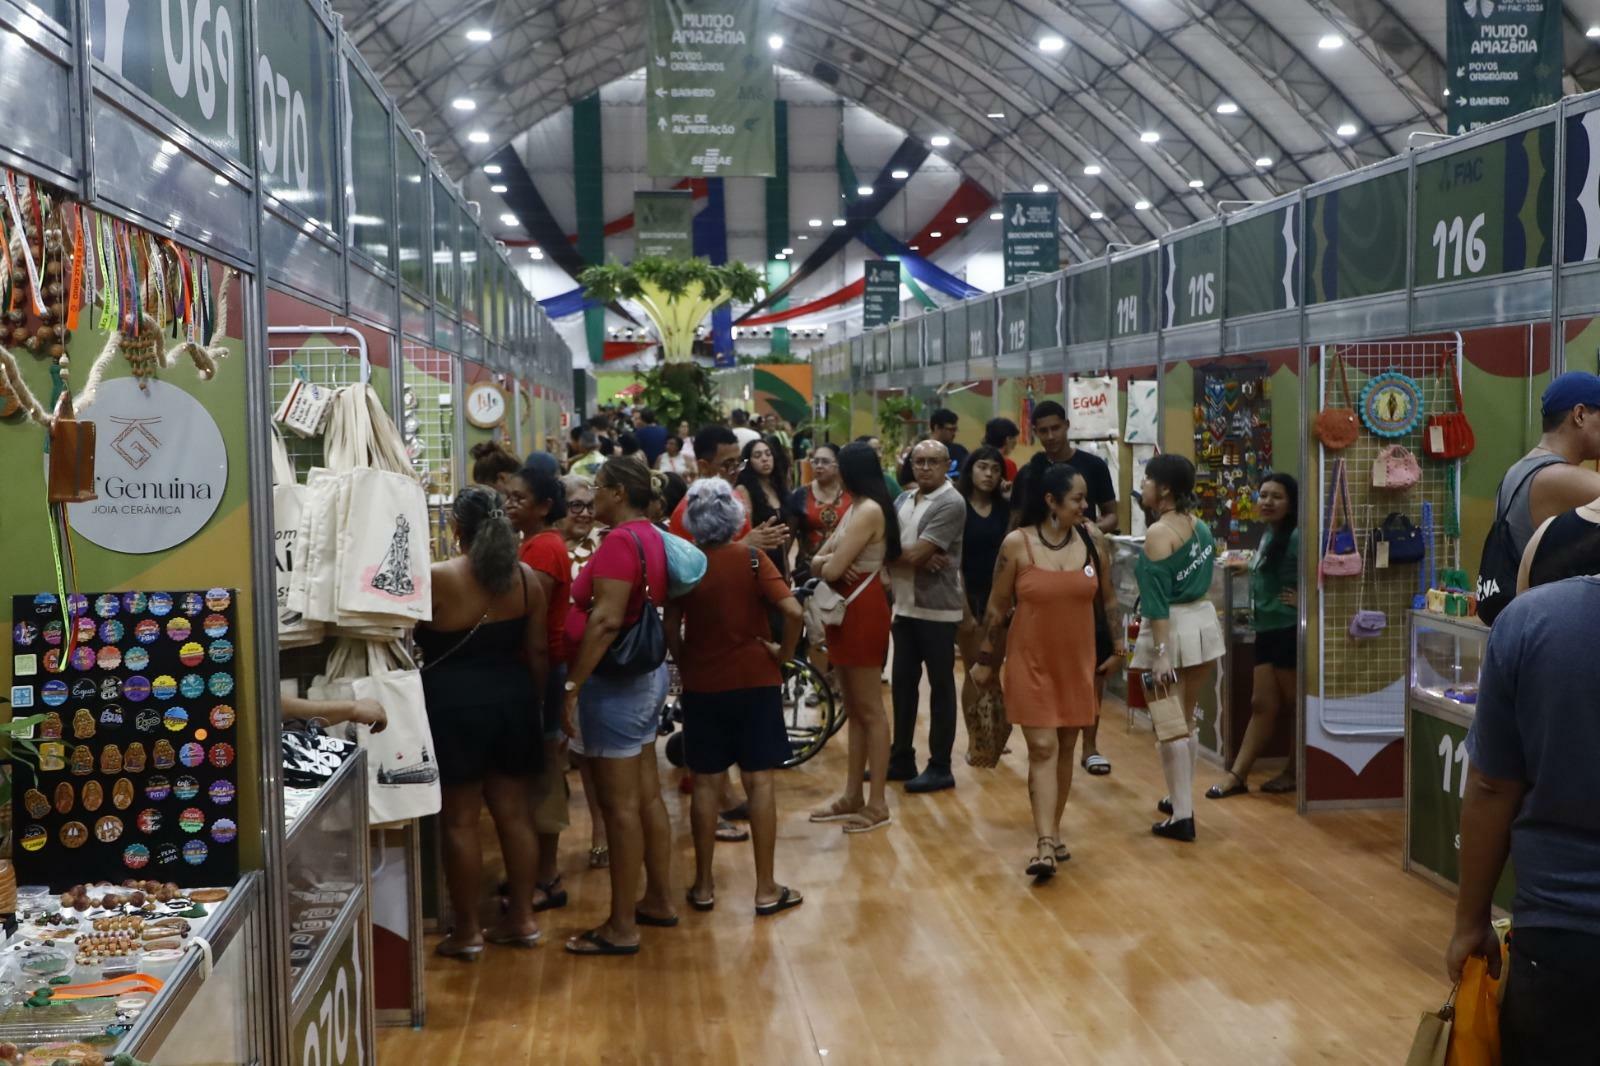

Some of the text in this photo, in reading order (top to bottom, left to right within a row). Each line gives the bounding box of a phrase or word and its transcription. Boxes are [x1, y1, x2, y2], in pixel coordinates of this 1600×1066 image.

[682, 14, 735, 27] MUNDO
[671, 28, 746, 45] AMAZÔNIA
[1481, 24, 1528, 38] MUNDO
[1471, 38, 1538, 54] AMAZÔNIA
[1469, 62, 1499, 71] POVOS
[260, 54, 309, 192] 070
[1432, 213, 1486, 279] 116
[1188, 273, 1215, 317] 115
[1117, 295, 1137, 334] 114
[1009, 319, 1025, 350] 113
[1073, 393, 1107, 409] EGUA
[92, 505, 118, 515] JOIA
[1439, 734, 1468, 798] 11
